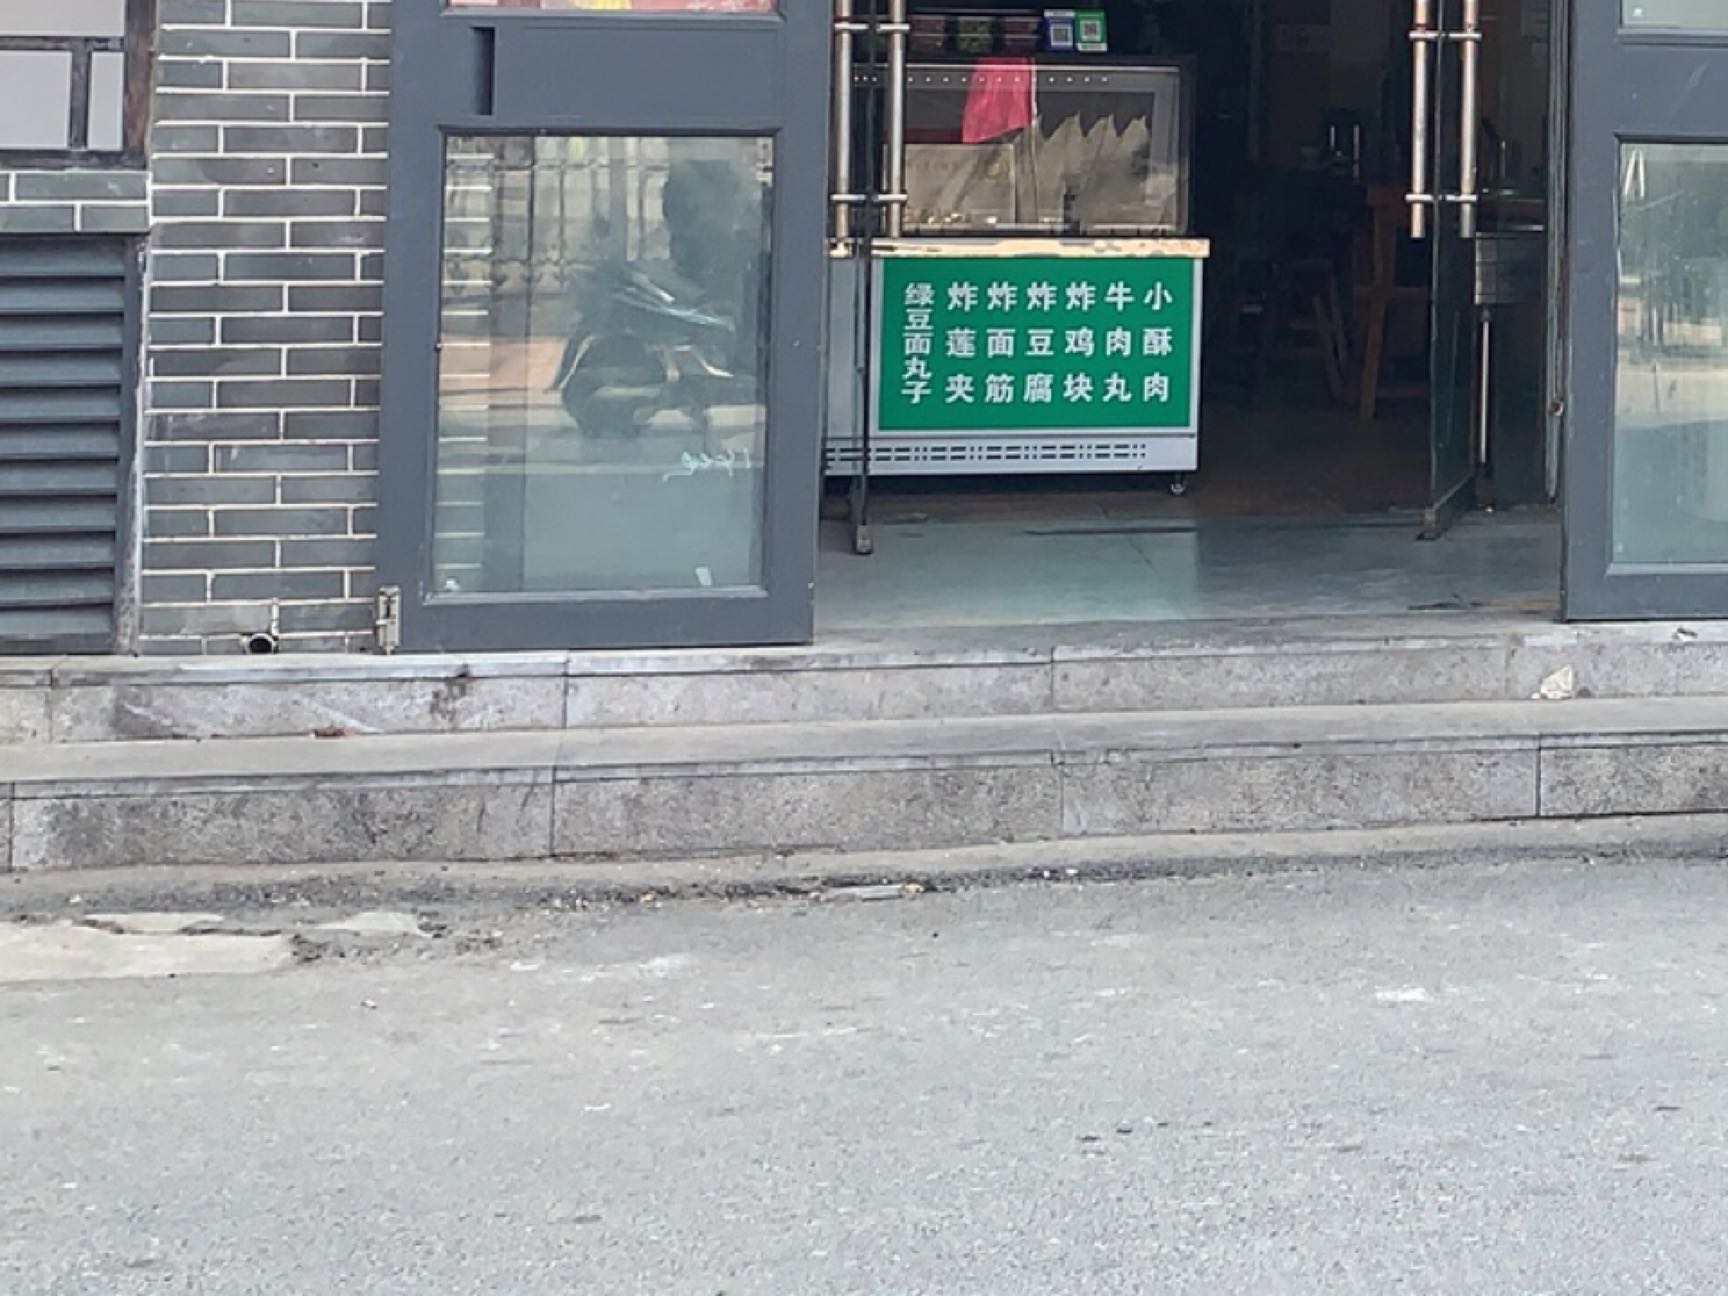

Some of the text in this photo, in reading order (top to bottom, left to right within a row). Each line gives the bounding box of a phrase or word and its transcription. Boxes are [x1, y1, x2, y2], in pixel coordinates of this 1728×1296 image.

[900, 282, 936, 404] 绿豆面丸子
[984, 280, 1018, 403] 炸面筋
[1023, 280, 1057, 403] 炸豆腐
[1063, 280, 1096, 403] 炸鸡块
[1102, 280, 1135, 402] 牛肉丸
[1142, 280, 1174, 402] 小酥肉
